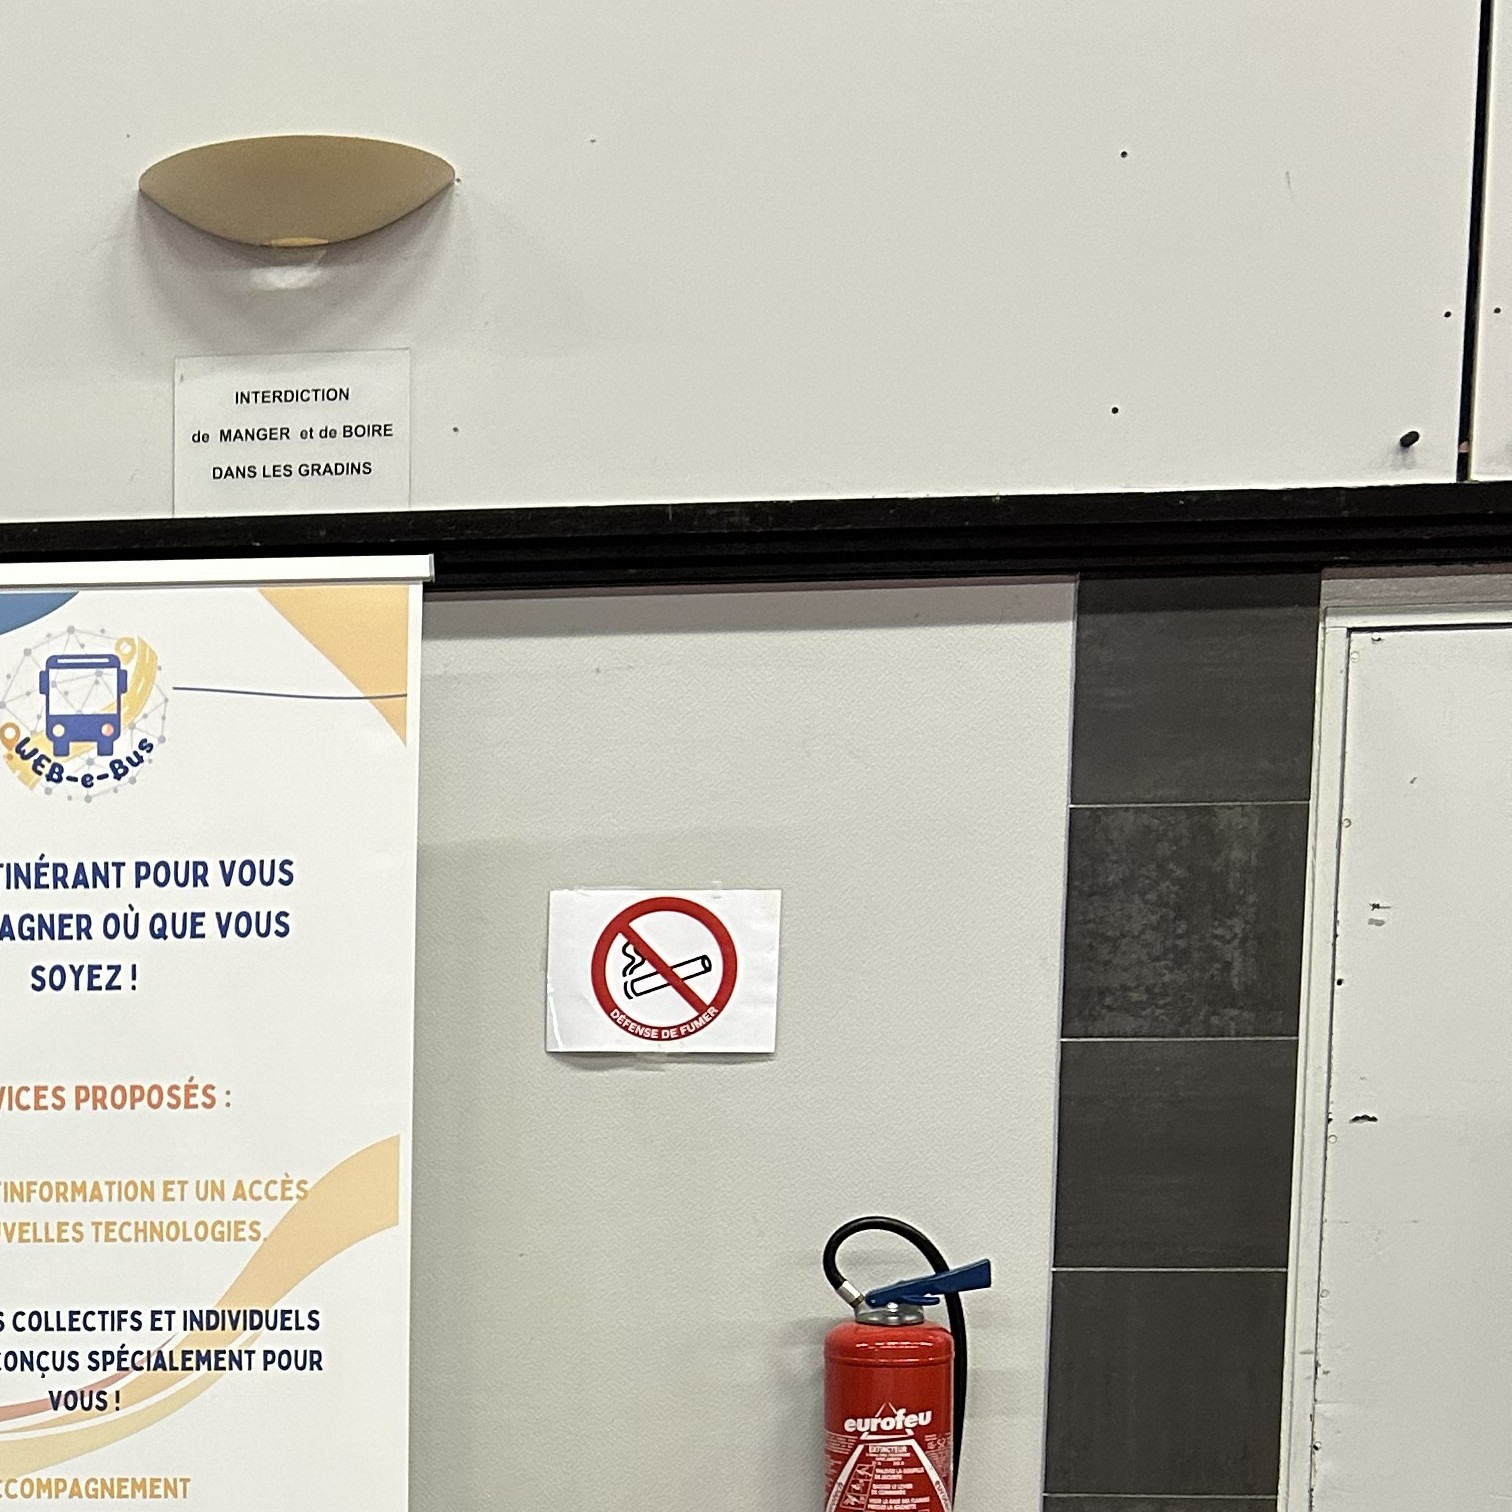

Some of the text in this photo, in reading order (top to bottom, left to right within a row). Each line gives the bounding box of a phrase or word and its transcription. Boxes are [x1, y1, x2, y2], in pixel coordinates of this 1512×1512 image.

[235, 387, 350, 405] INTERDICTION
[191, 423, 393, 443] de MANGER et de BOIRE
[212, 461, 372, 480] DANS LES GRADINS
[134, 860, 210, 889] POUR
[219, 858, 294, 887] VOUS
[103, 905, 140, 940] OÙ
[149, 913, 206, 942] QUE
[215, 910, 291, 939] VOUS
[30, 964, 138, 992] SOYEZ !
[610, 1006, 719, 1039] DÉFENSE DE FUMER
[74, 1077, 218, 1112] PROPOSÉS
[224, 1087, 231, 1108] :
[162, 1180, 188, 1202] ET
[195, 1180, 226, 1202] UN
[232, 1171, 309, 1202] ACCÈS
[91, 1219, 267, 1244] TECHNOLOGIES.
[12, 1310, 143, 1332] COLLECTIFS
[150, 1309, 175, 1331] ET
[182, 1308, 320, 1331] INDIVIDUELS
[87, 1343, 256, 1373] SPÉCIALEMENT
[263, 1348, 323, 1371] POUR
[48, 1389, 121, 1412] VOUS !
[844, 1408, 932, 1433] eurofeu
